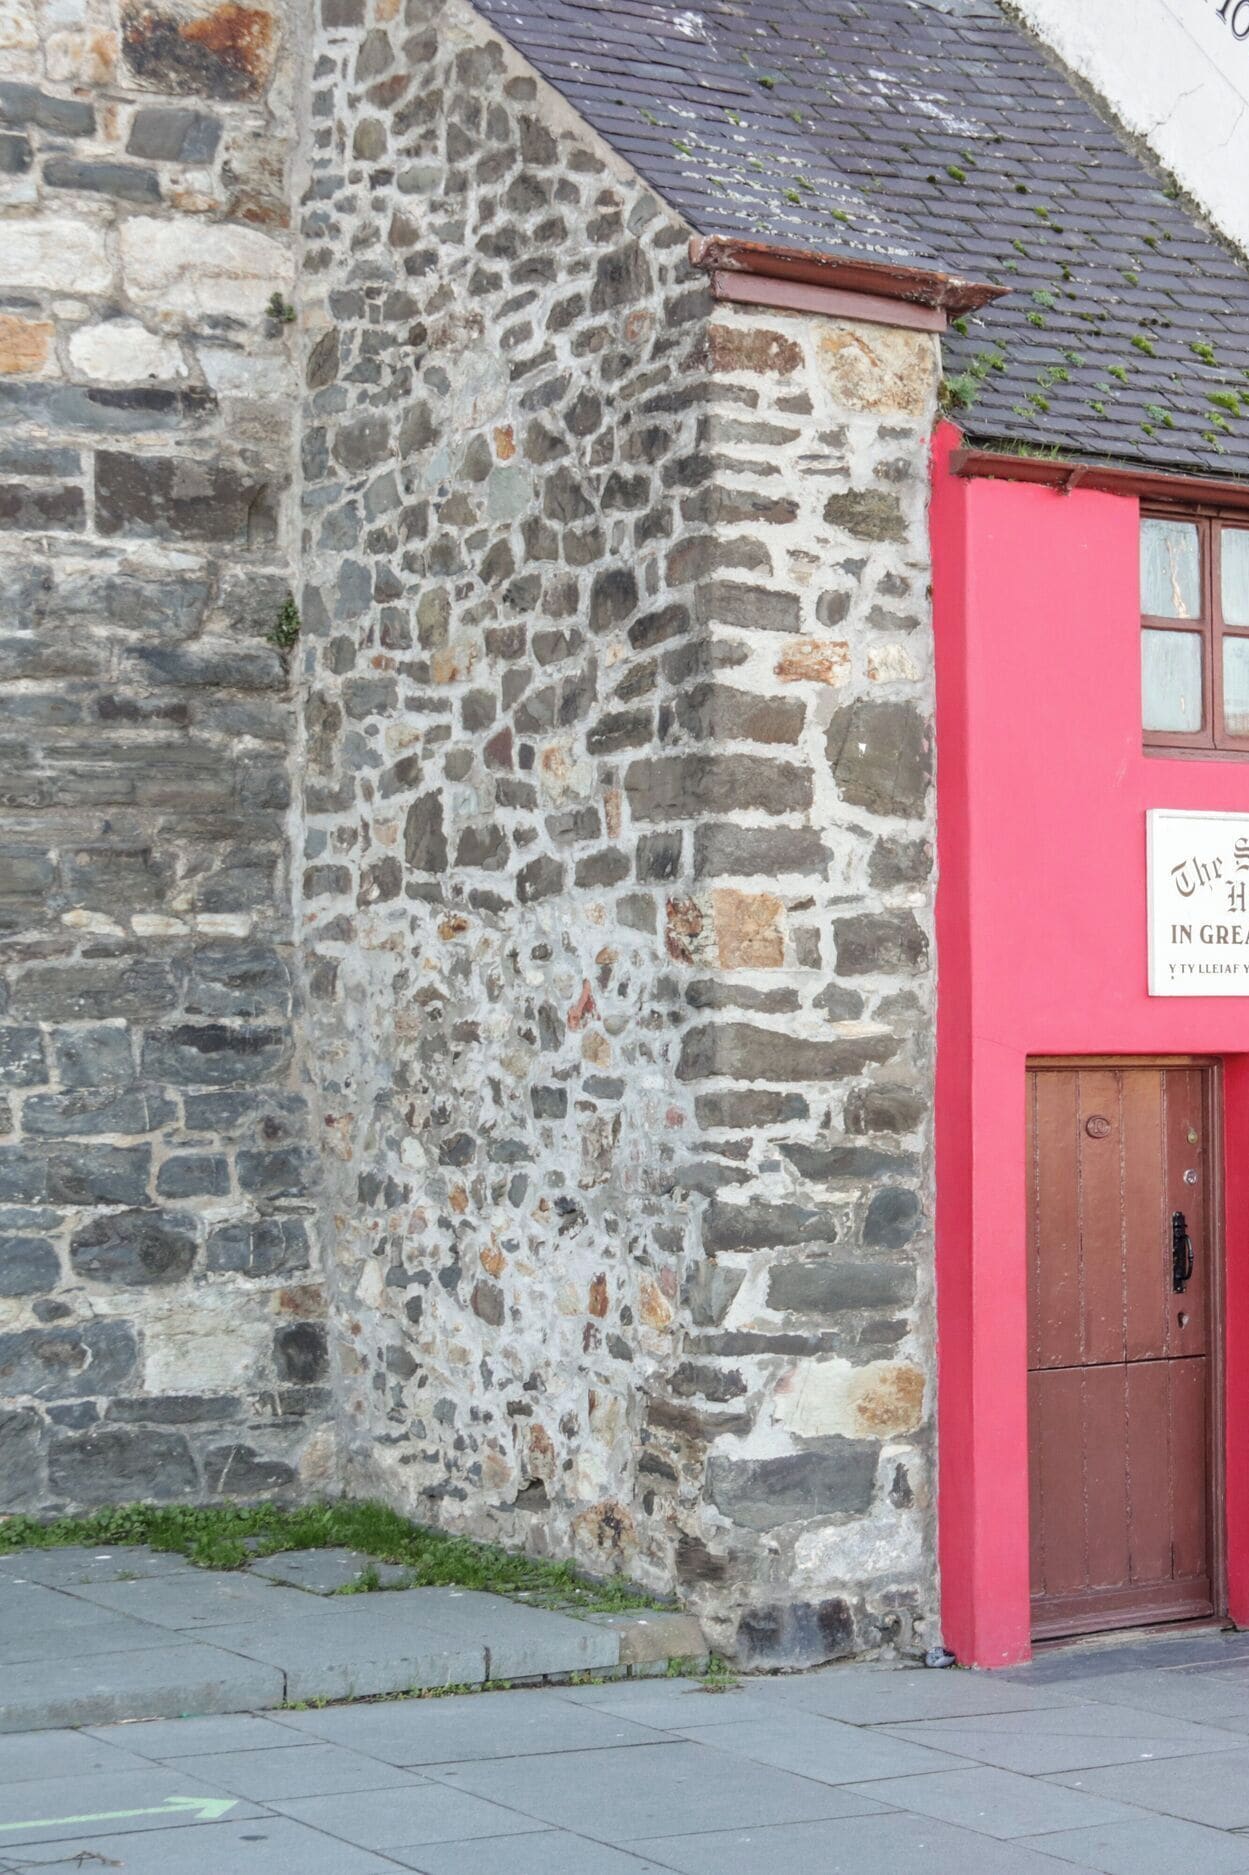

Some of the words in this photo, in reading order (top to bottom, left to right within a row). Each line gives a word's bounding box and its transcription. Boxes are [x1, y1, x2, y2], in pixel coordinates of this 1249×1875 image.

[1170, 855, 1223, 897] The
[1171, 924, 1193, 944] IN
[1169, 964, 1176, 974] Y
[1180, 963, 1195, 974] TY
[1199, 963, 1240, 974] LLEIAF
